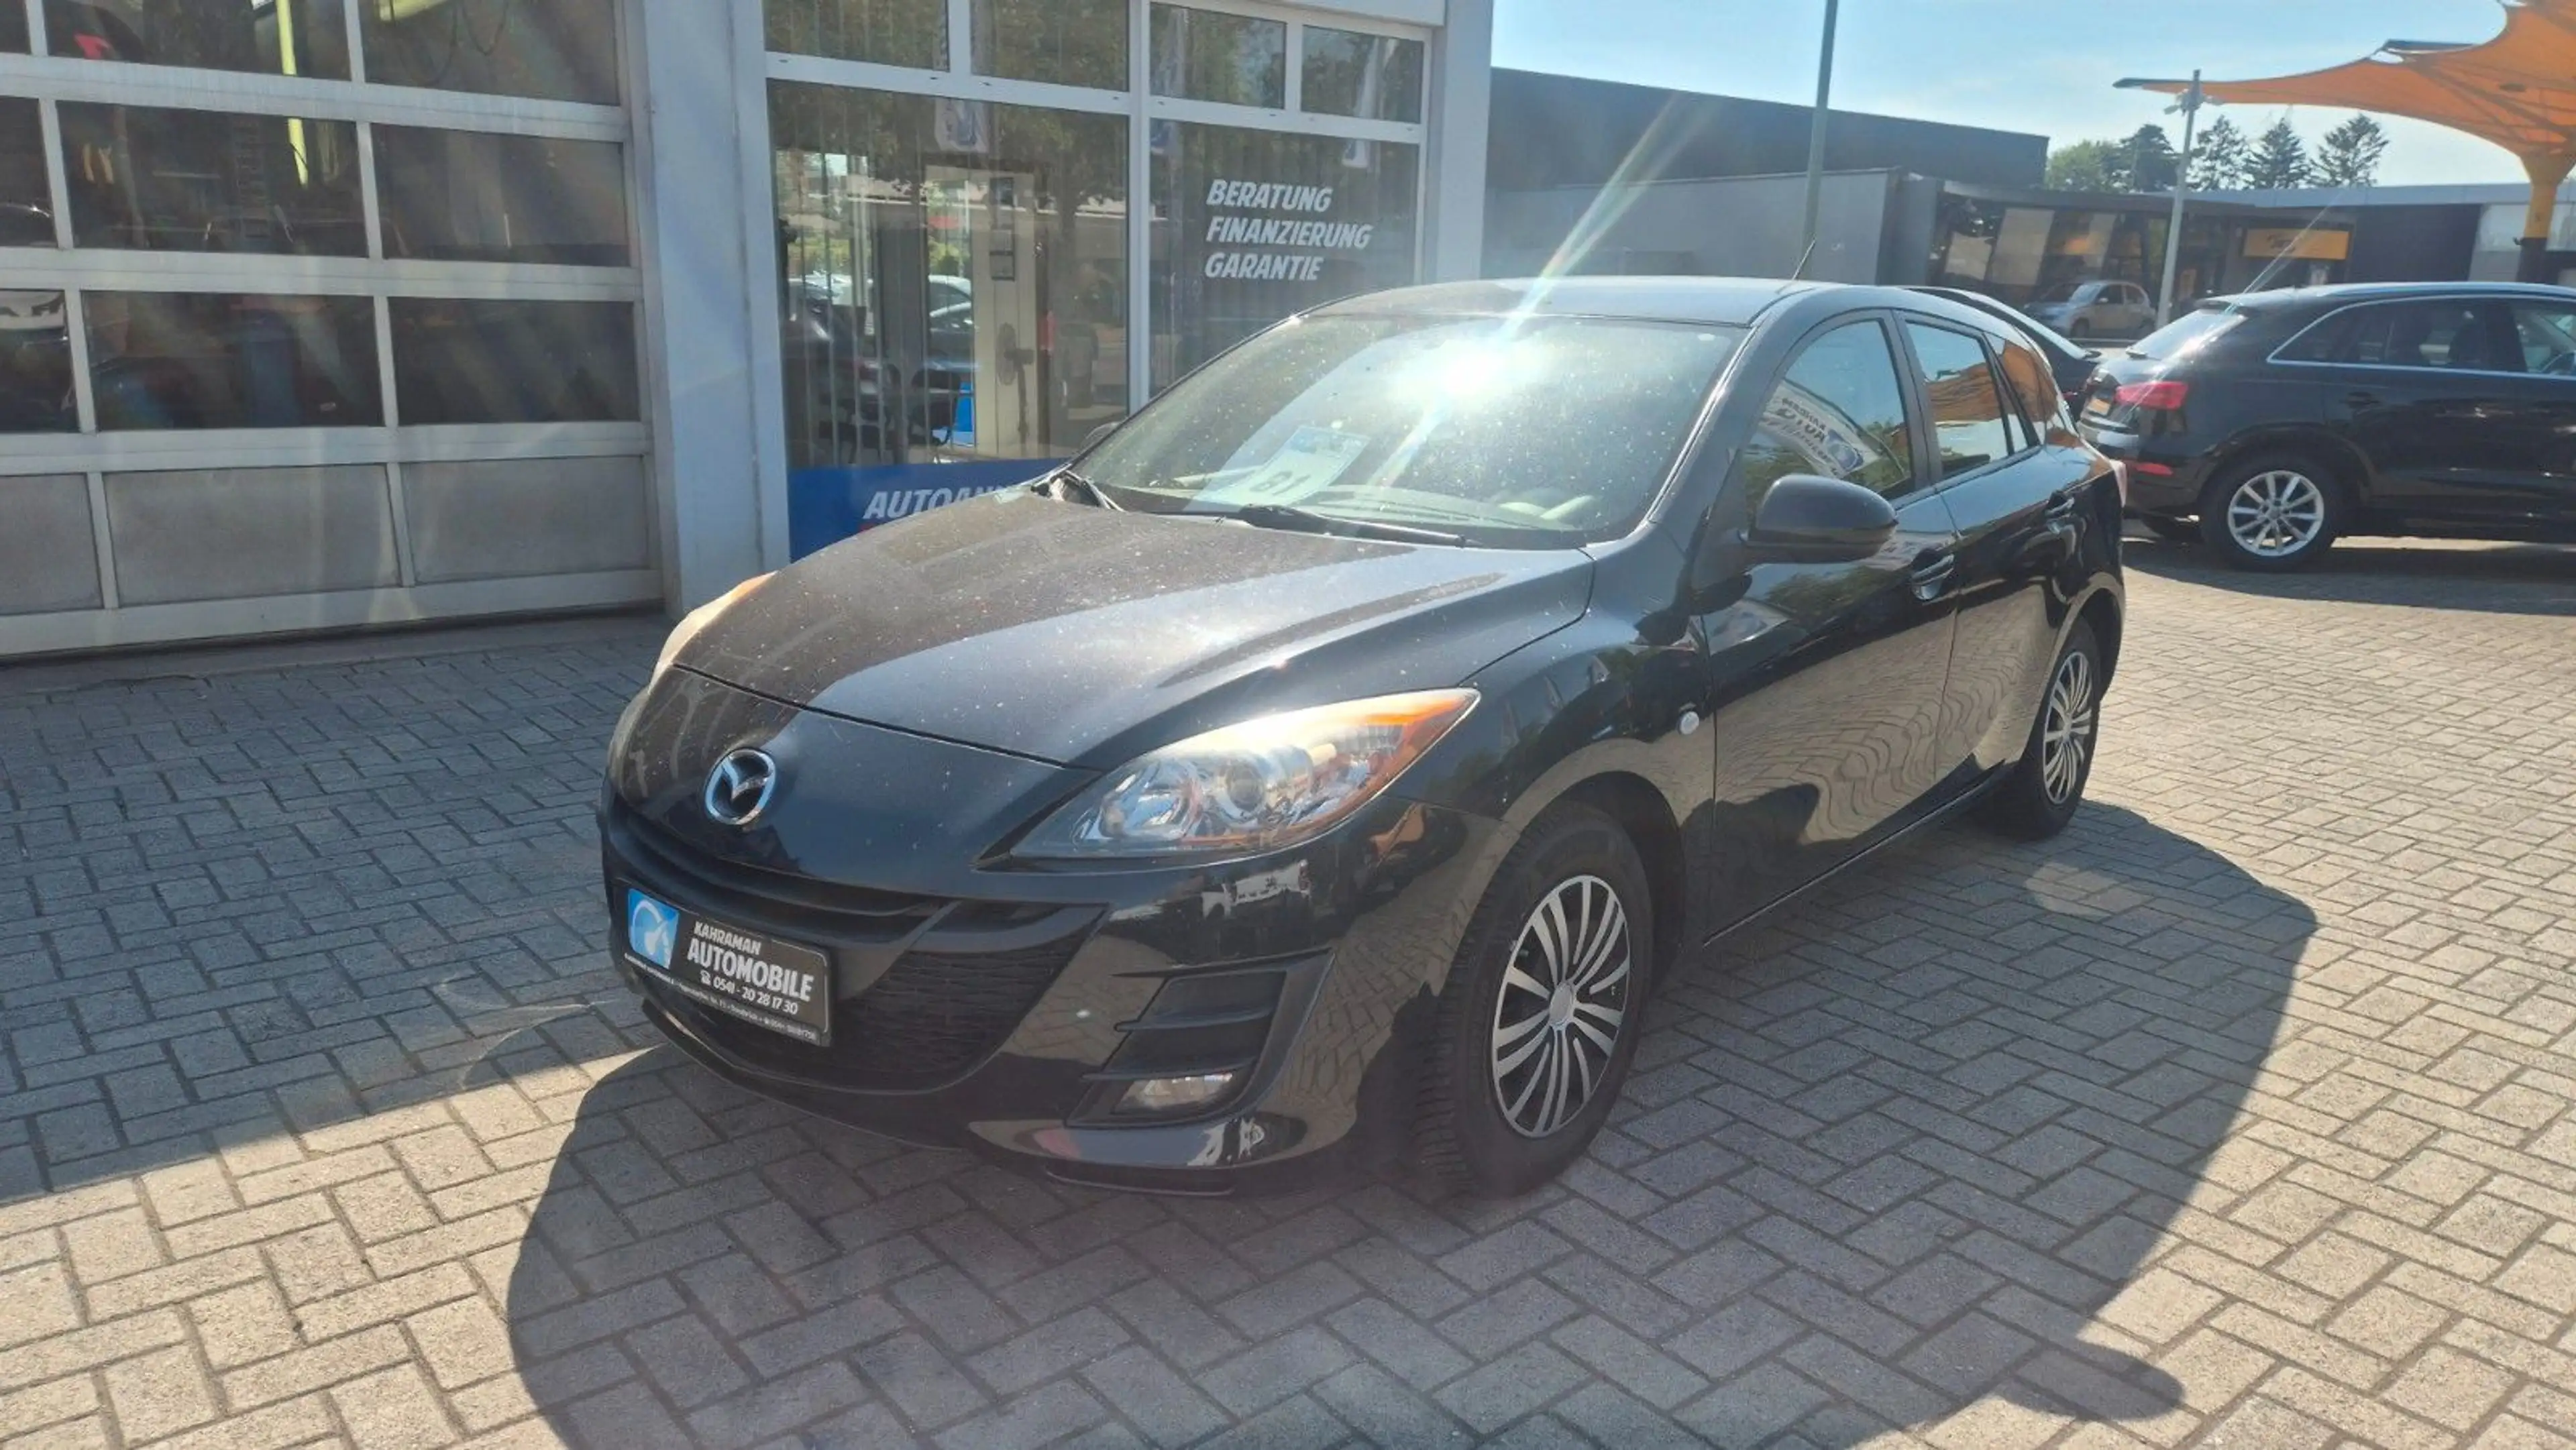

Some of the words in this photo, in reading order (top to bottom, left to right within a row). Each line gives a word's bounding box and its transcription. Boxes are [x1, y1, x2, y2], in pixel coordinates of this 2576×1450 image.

[1206, 179, 1333, 212] BERATUNG
[1206, 216, 1375, 249] FINANZIERUNG
[1205, 252, 1325, 281] GARANTIE
[694, 921, 761, 956] KAHRAMAN
[687, 938, 814, 1002] AUTOMOBILE
[742, 987, 755, 1001] 20
[757, 992, 771, 1007] 28
[772, 997, 784, 1009] 17
[784, 1001, 798, 1015] 30
